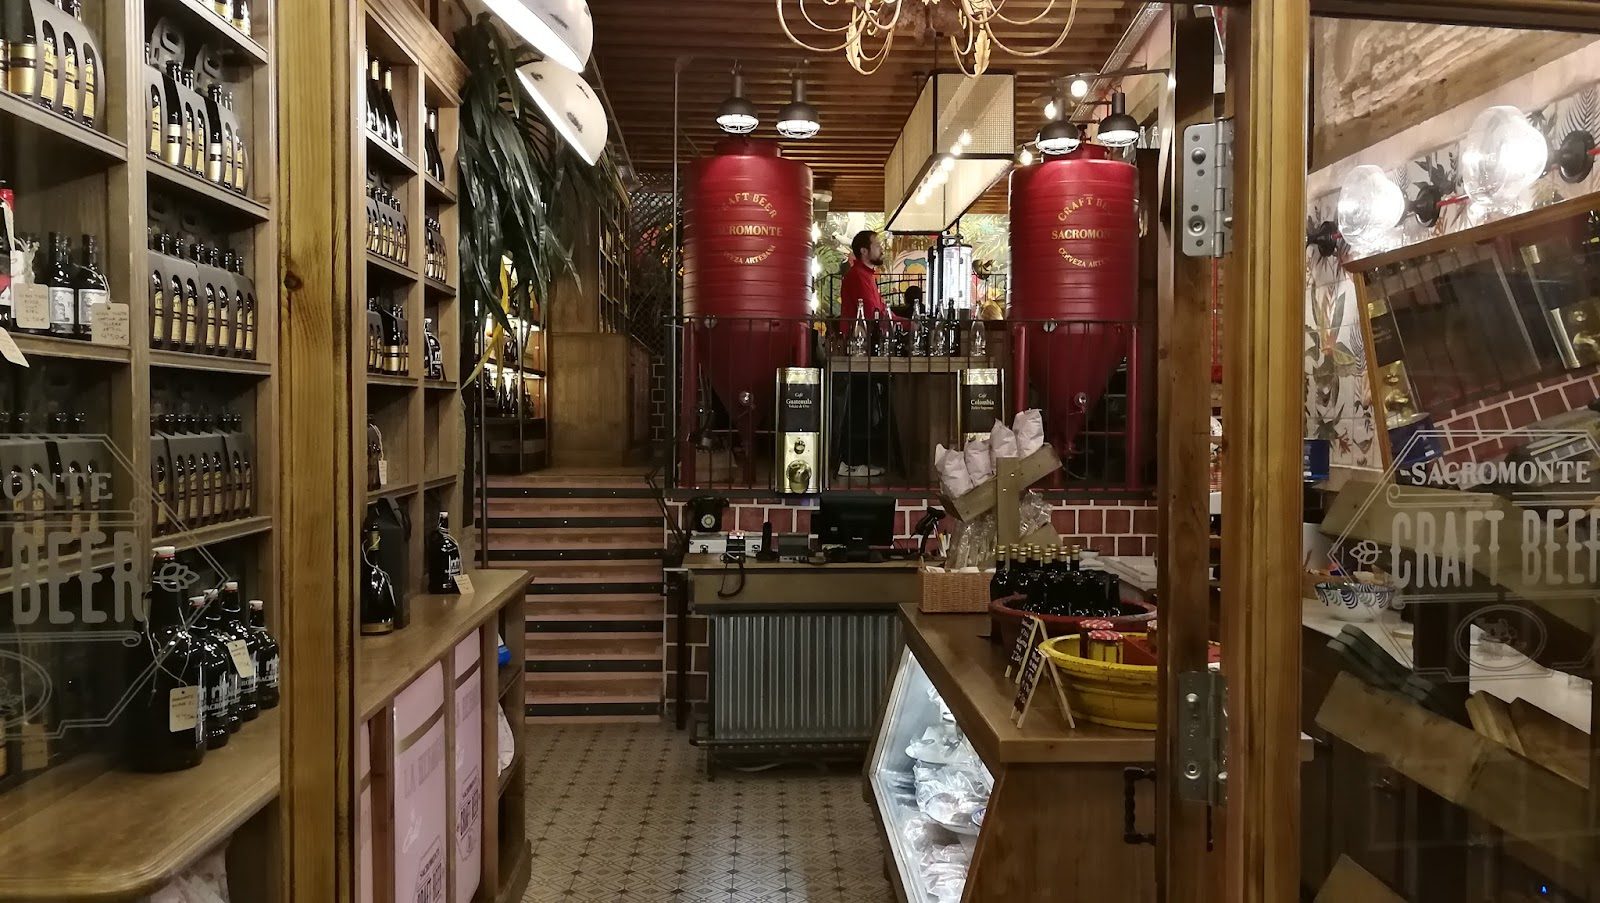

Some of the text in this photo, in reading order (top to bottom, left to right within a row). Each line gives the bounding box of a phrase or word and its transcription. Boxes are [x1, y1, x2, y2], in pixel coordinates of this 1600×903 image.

[752, 194, 778, 218] BEER
[1058, 196, 1094, 222] CRAFT
[1411, 460, 1592, 486] SACROMONTE
[1390, 510, 1505, 589] CRAFT
[11, 530, 145, 625] BEER
